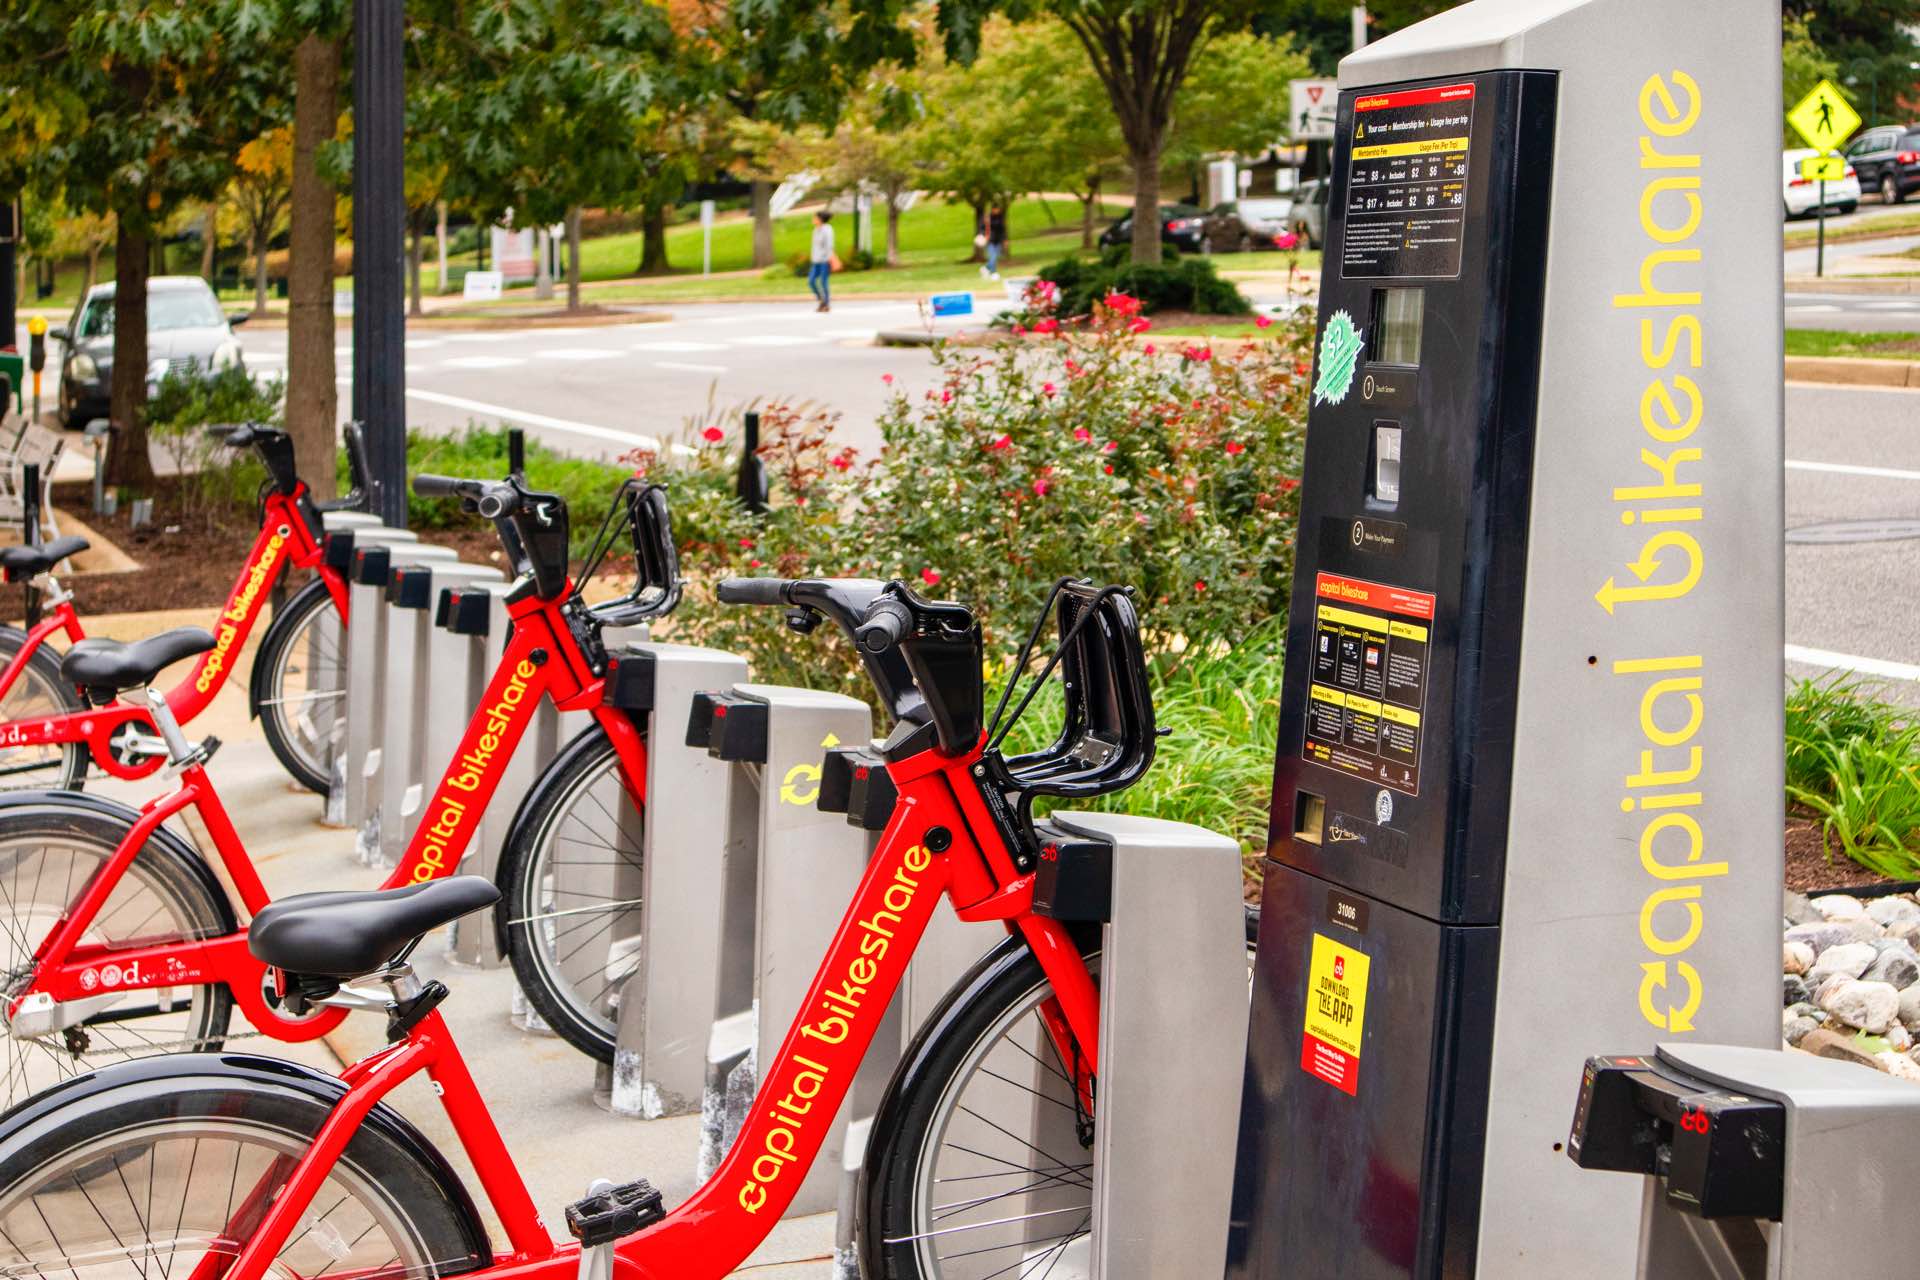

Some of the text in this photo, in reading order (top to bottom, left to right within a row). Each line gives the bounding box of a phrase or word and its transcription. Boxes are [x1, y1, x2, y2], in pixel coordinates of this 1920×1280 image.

[1368, 125, 1378, 134] Your
[1378, 124, 1388, 132] cost
[1392, 122, 1417, 131] Membership
[1430, 118, 1444, 128] Usage
[1452, 117, 1460, 126] per
[1460, 115, 1468, 125] trip
[1420, 144, 1432, 152] Usage
[1432, 143, 1440, 151] Fee
[1371, 170, 1378, 181] $8
[1389, 171, 1406, 180] Included
[1412, 167, 1420, 178] $2
[1429, 166, 1438, 176] $6
[1366, 198, 1377, 210] $17
[1386, 200, 1404, 208] Included
[1408, 196, 1416, 207] $2
[1594, 69, 1703, 616] bikeshare
[225, 535, 284, 622] bikeshare
[1320, 582, 1368, 600] capital bikeshare
[196, 624, 238, 693] capital
[447, 660, 536, 792] bikeshare
[1613, 655, 1728, 1032] capital
[1338, 902, 1356, 920] 31006
[800, 845, 931, 1045] bikeshare
[1315, 988, 1332, 1018] THE
[1321, 976, 1350, 1000] DOWNLOAD
[1332, 998, 1354, 1028] APP
[738, 1054, 829, 1214] capital
